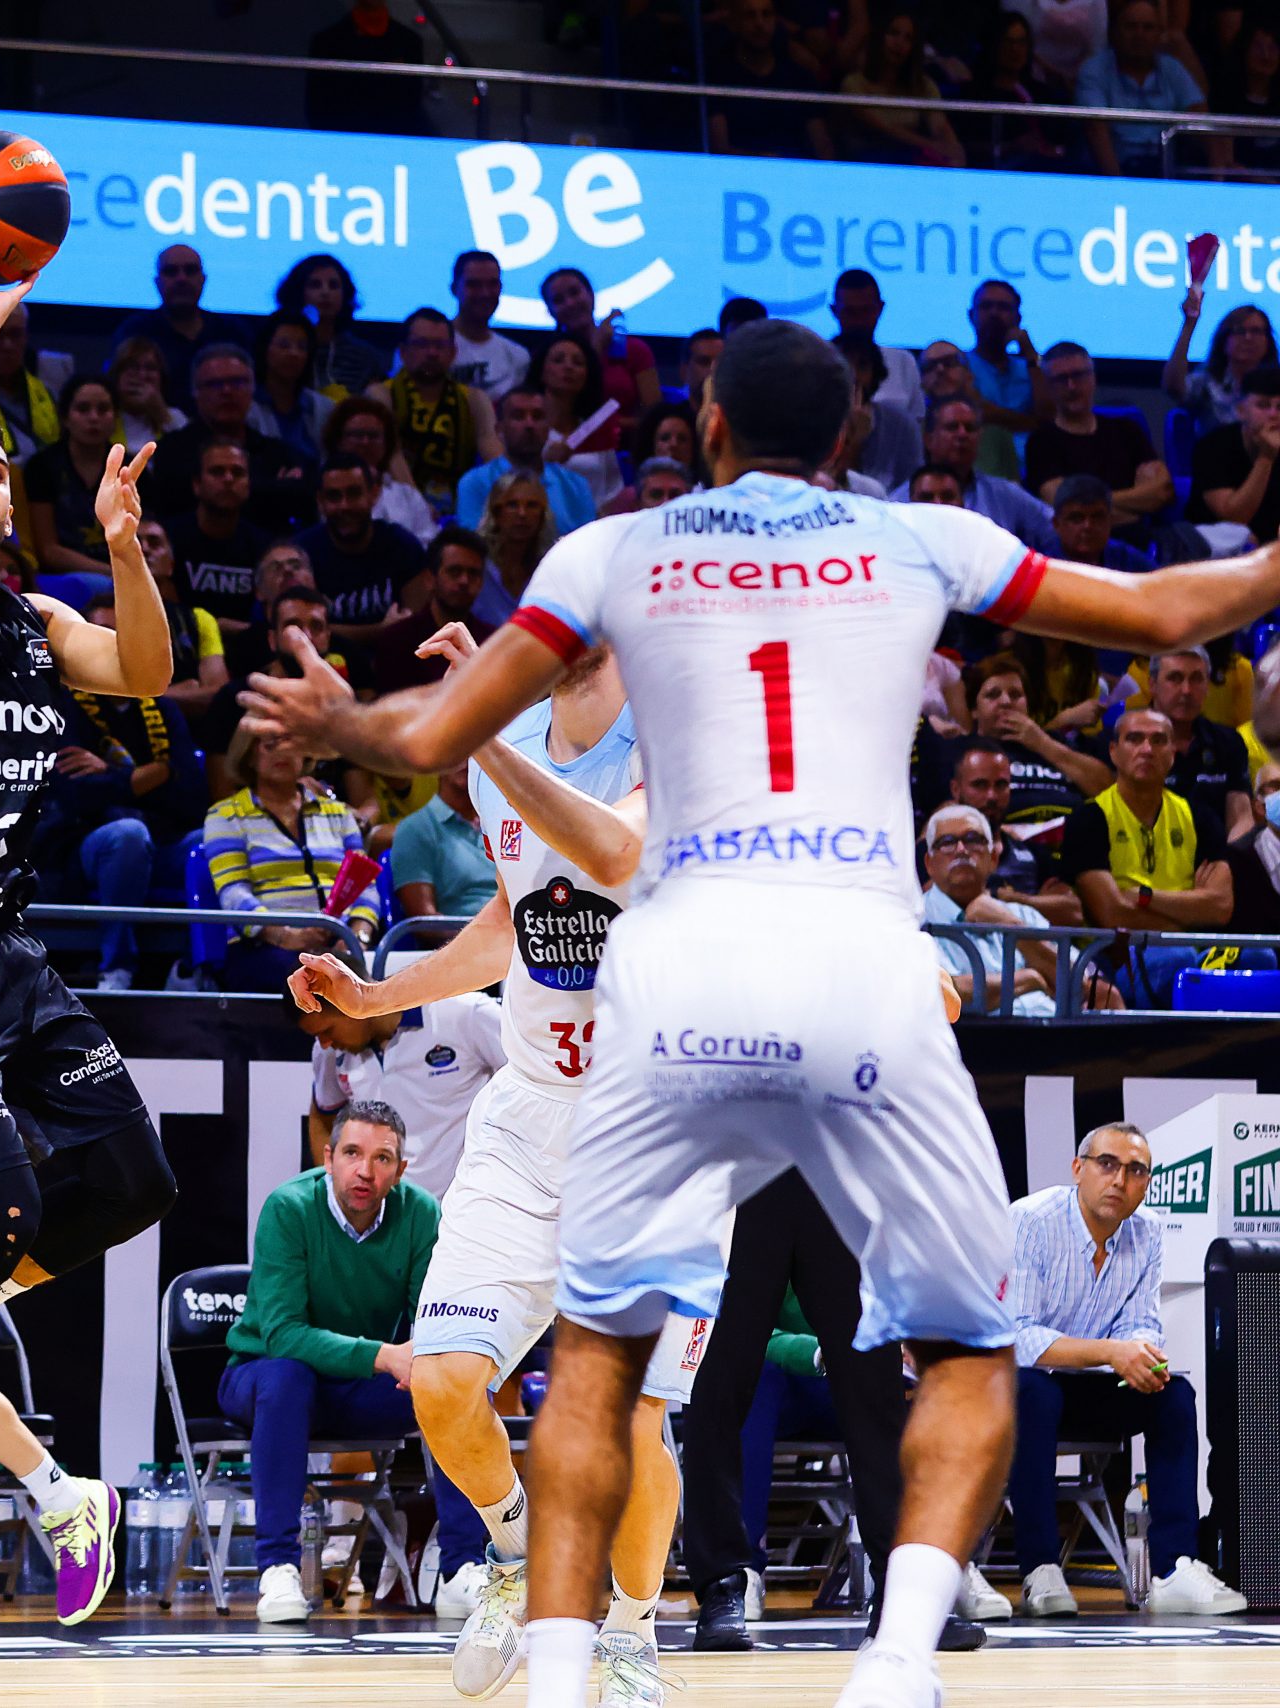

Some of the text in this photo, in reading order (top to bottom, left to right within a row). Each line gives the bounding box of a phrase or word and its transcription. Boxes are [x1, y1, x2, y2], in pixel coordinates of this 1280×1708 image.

[456, 142, 645, 269] Be
[186, 560, 254, 594] VANS
[692, 554, 876, 589] cenor
[749, 641, 795, 793] 1
[523, 909, 610, 936] Estrella
[557, 964, 585, 987] 0,0
[650, 1028, 804, 1062] A Coruña
[1233, 1221, 1255, 1233] SALUD
